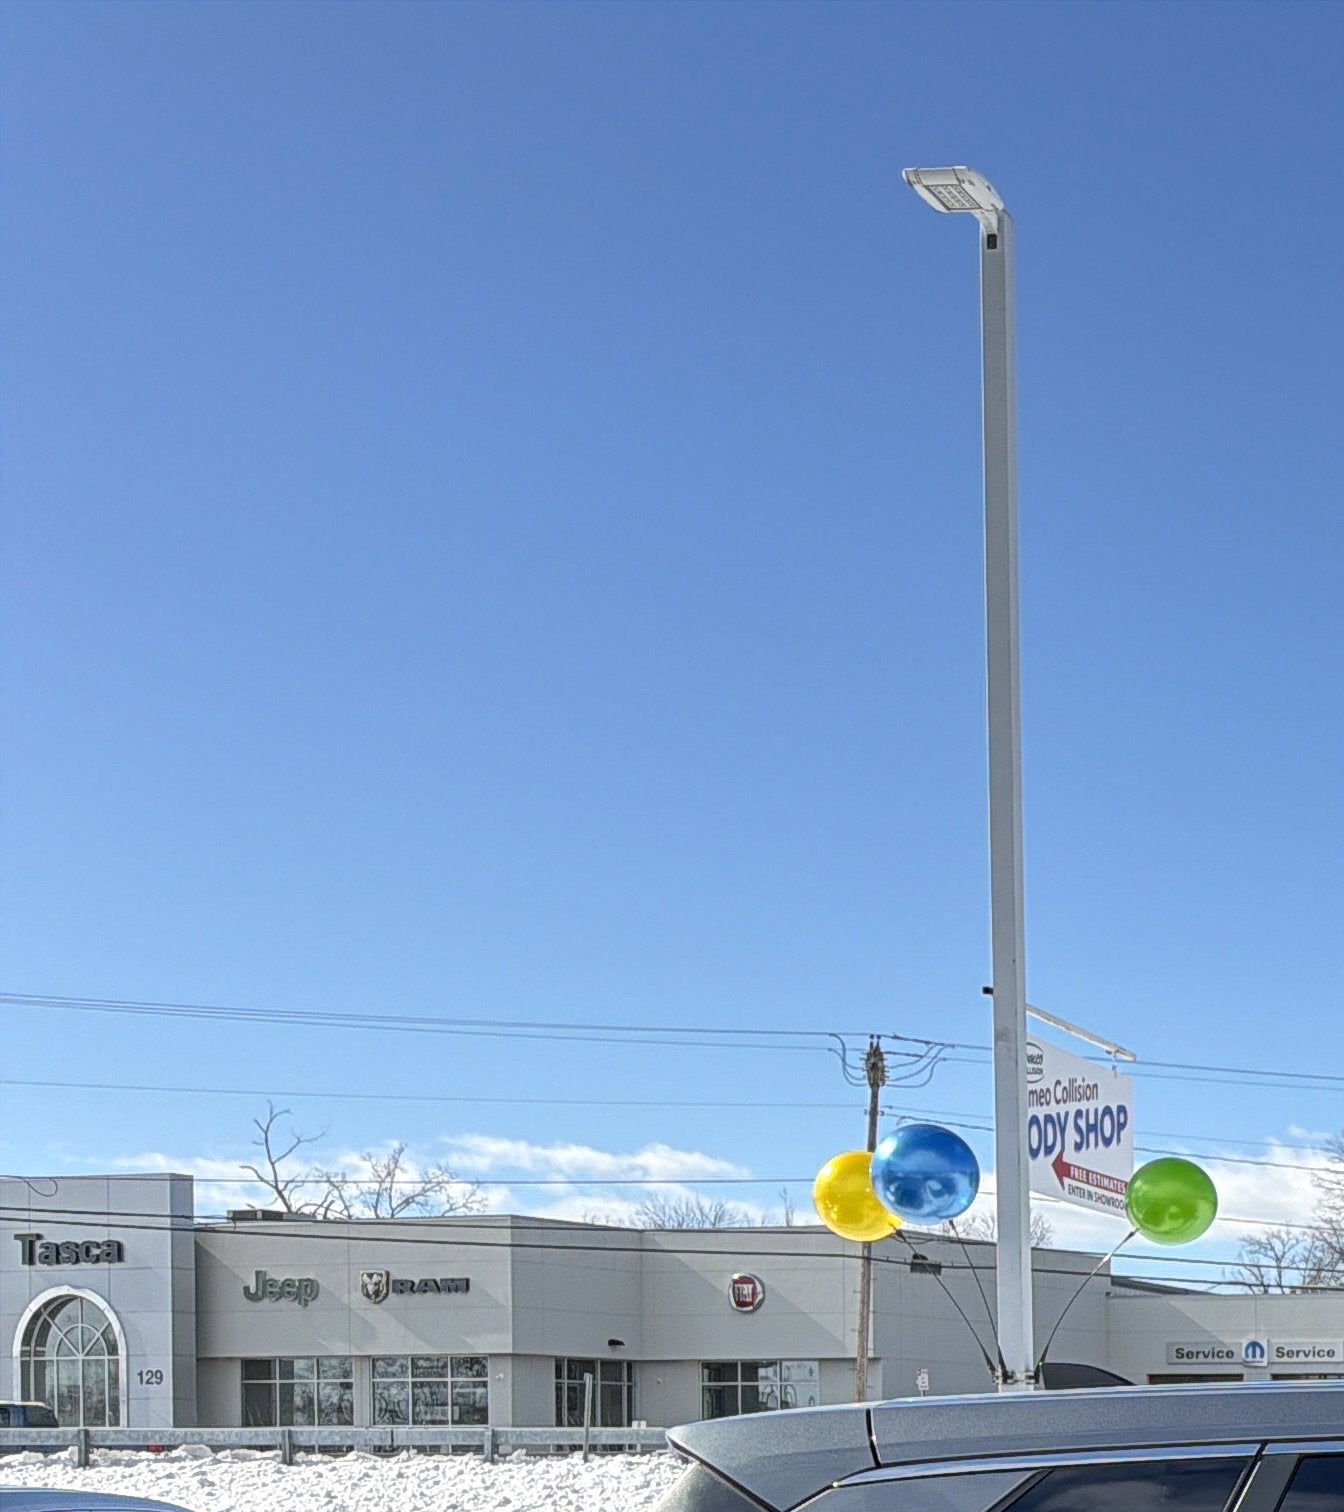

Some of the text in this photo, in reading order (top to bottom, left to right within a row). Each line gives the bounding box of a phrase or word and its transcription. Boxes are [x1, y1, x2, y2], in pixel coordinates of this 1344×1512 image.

[1028, 1077, 1099, 1108] meo Collision
[1028, 1104, 1128, 1161] ODY SHOP
[1070, 1166, 1126, 1194] FREE ESTIMATES
[1068, 1183, 1127, 1211] ENTER IN SHOWROO
[13, 1233, 125, 1266] Tasca
[243, 1270, 320, 1307] Jeep
[392, 1278, 470, 1294] RAM
[1175, 1347, 1235, 1360] Service
[1276, 1346, 1336, 1359] Service
[136, 1369, 164, 1386] 129
